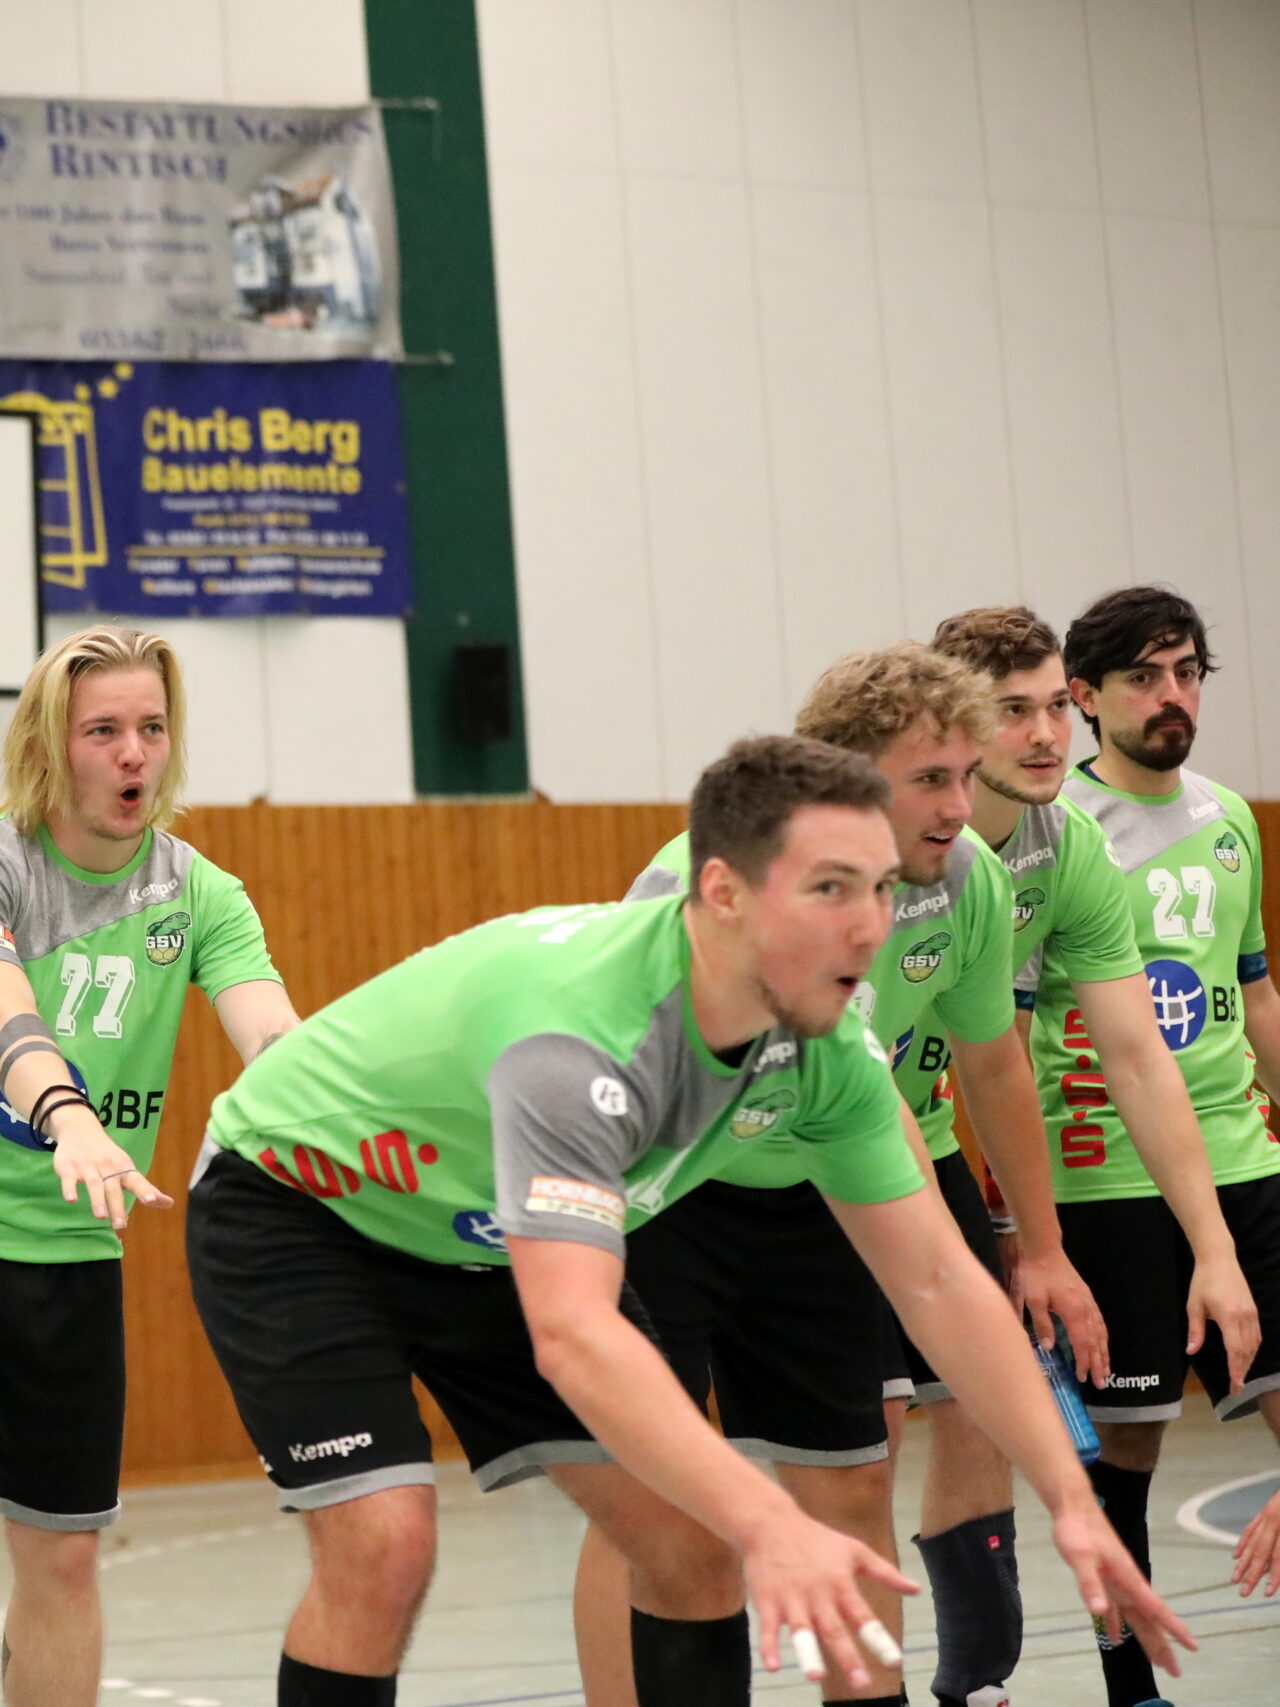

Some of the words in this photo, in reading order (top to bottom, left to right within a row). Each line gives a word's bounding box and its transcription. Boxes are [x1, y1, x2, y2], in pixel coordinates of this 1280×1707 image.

[142, 407, 252, 453] Chris
[258, 407, 361, 464] Berg
[1004, 847, 1054, 874] Kempa
[1214, 847, 1239, 860] GSV
[1146, 866, 1216, 941] 27
[146, 934, 183, 949] GSV
[902, 954, 940, 969] GSV
[54, 952, 136, 1039] 77
[1105, 1372, 1160, 1391] Kempa
[288, 1431, 373, 1462] Kempa
